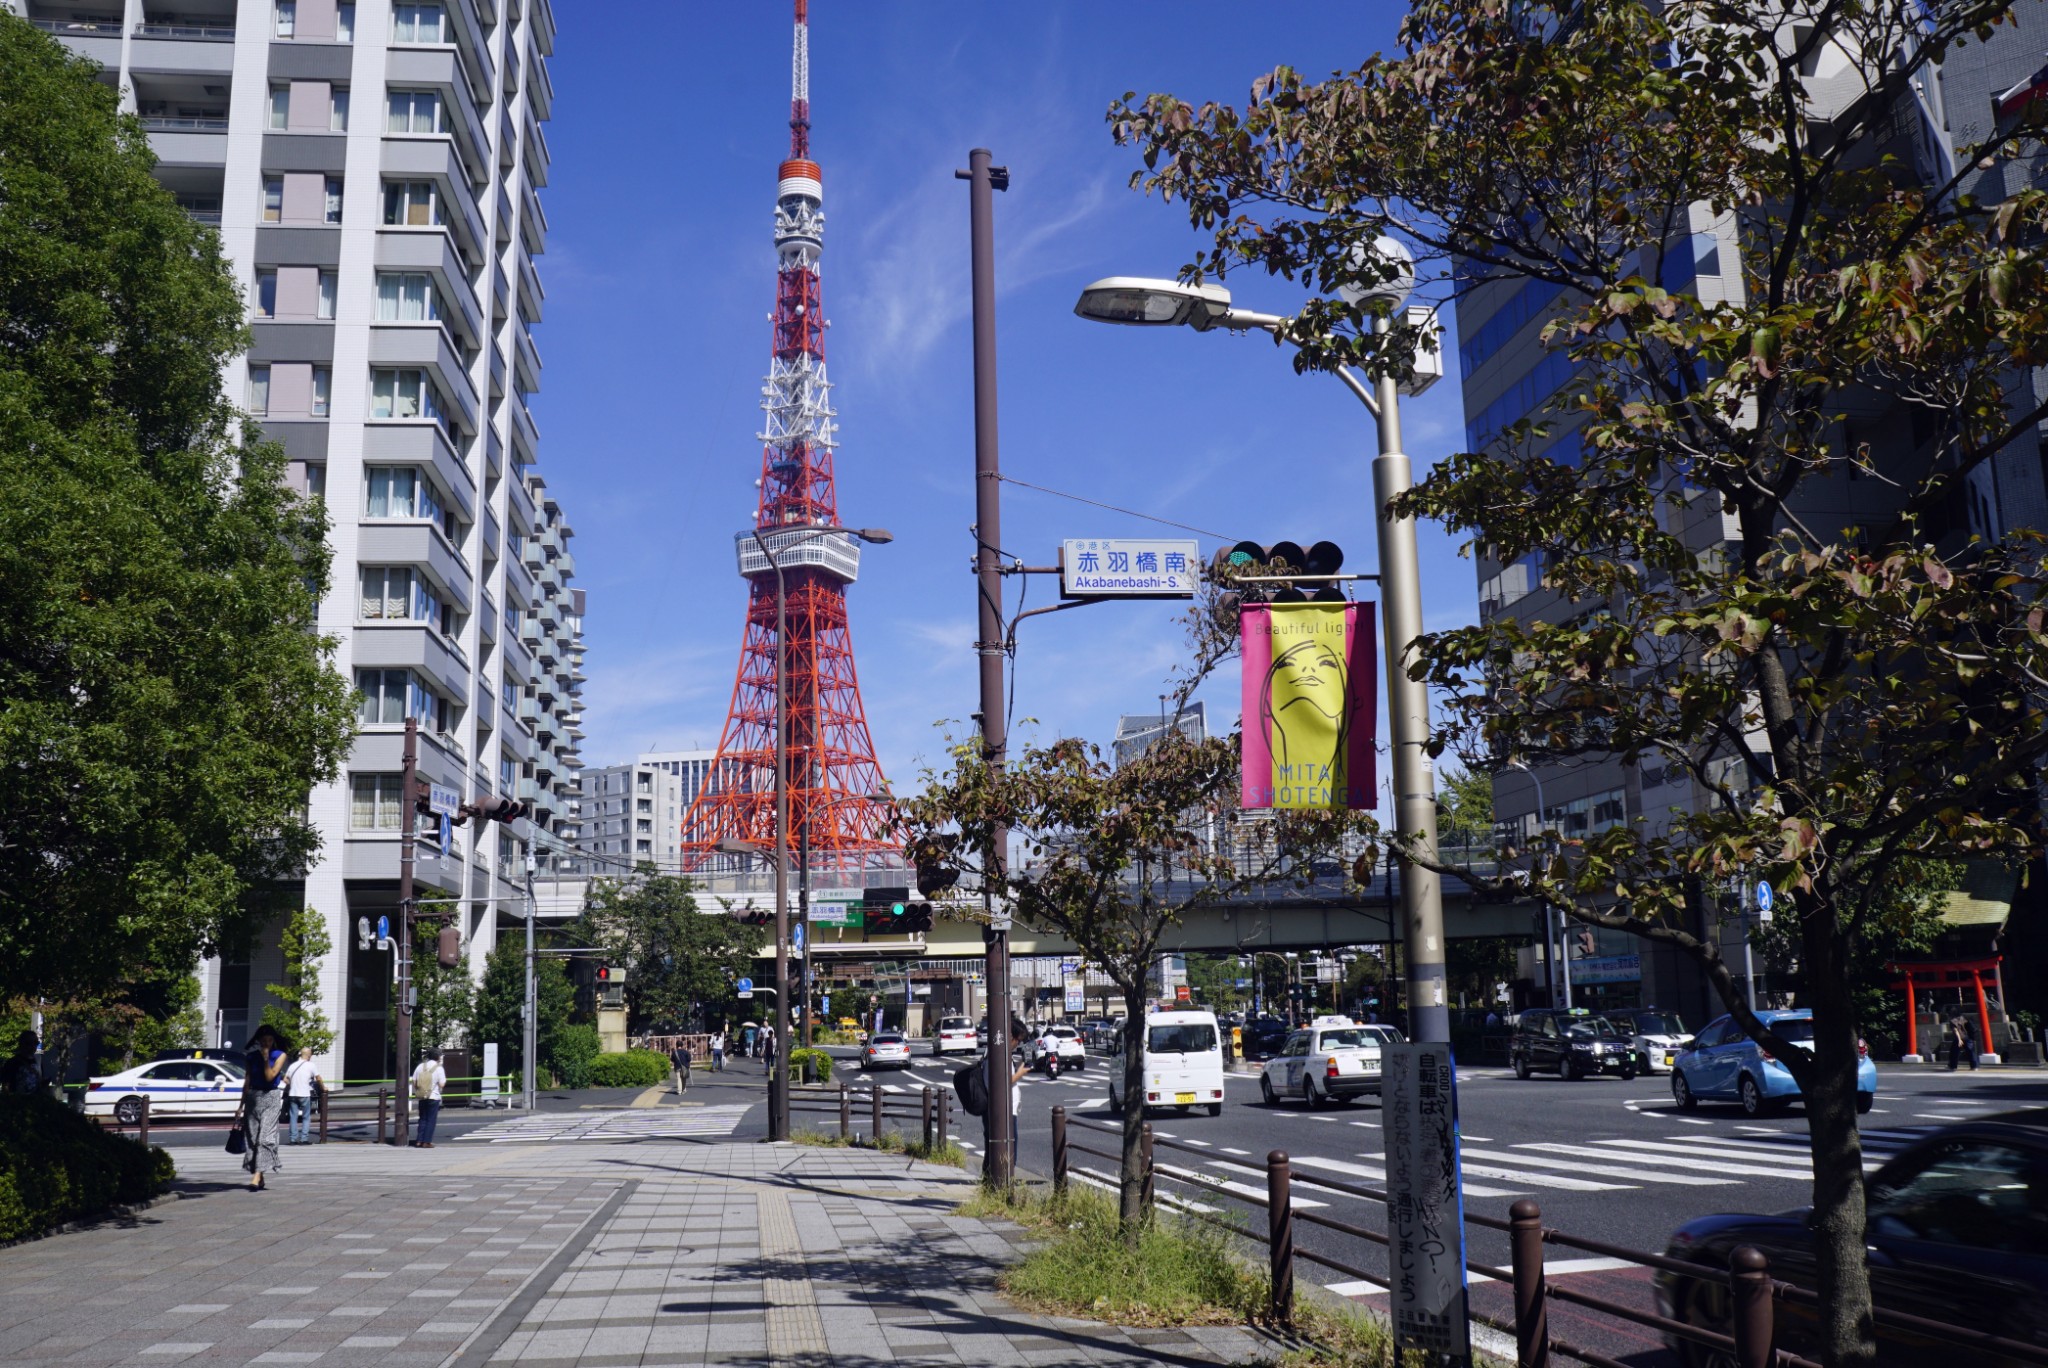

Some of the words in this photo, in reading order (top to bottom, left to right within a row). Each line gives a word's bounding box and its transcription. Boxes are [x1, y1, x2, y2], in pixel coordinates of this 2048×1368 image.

[1088, 541, 1111, 550] 港区
[1077, 552, 1186, 573] 赤羽橋南
[1075, 576, 1179, 588] Akabanebashi-S.
[1255, 622, 1319, 635] Beautiful
[1279, 763, 1342, 782] MITA!
